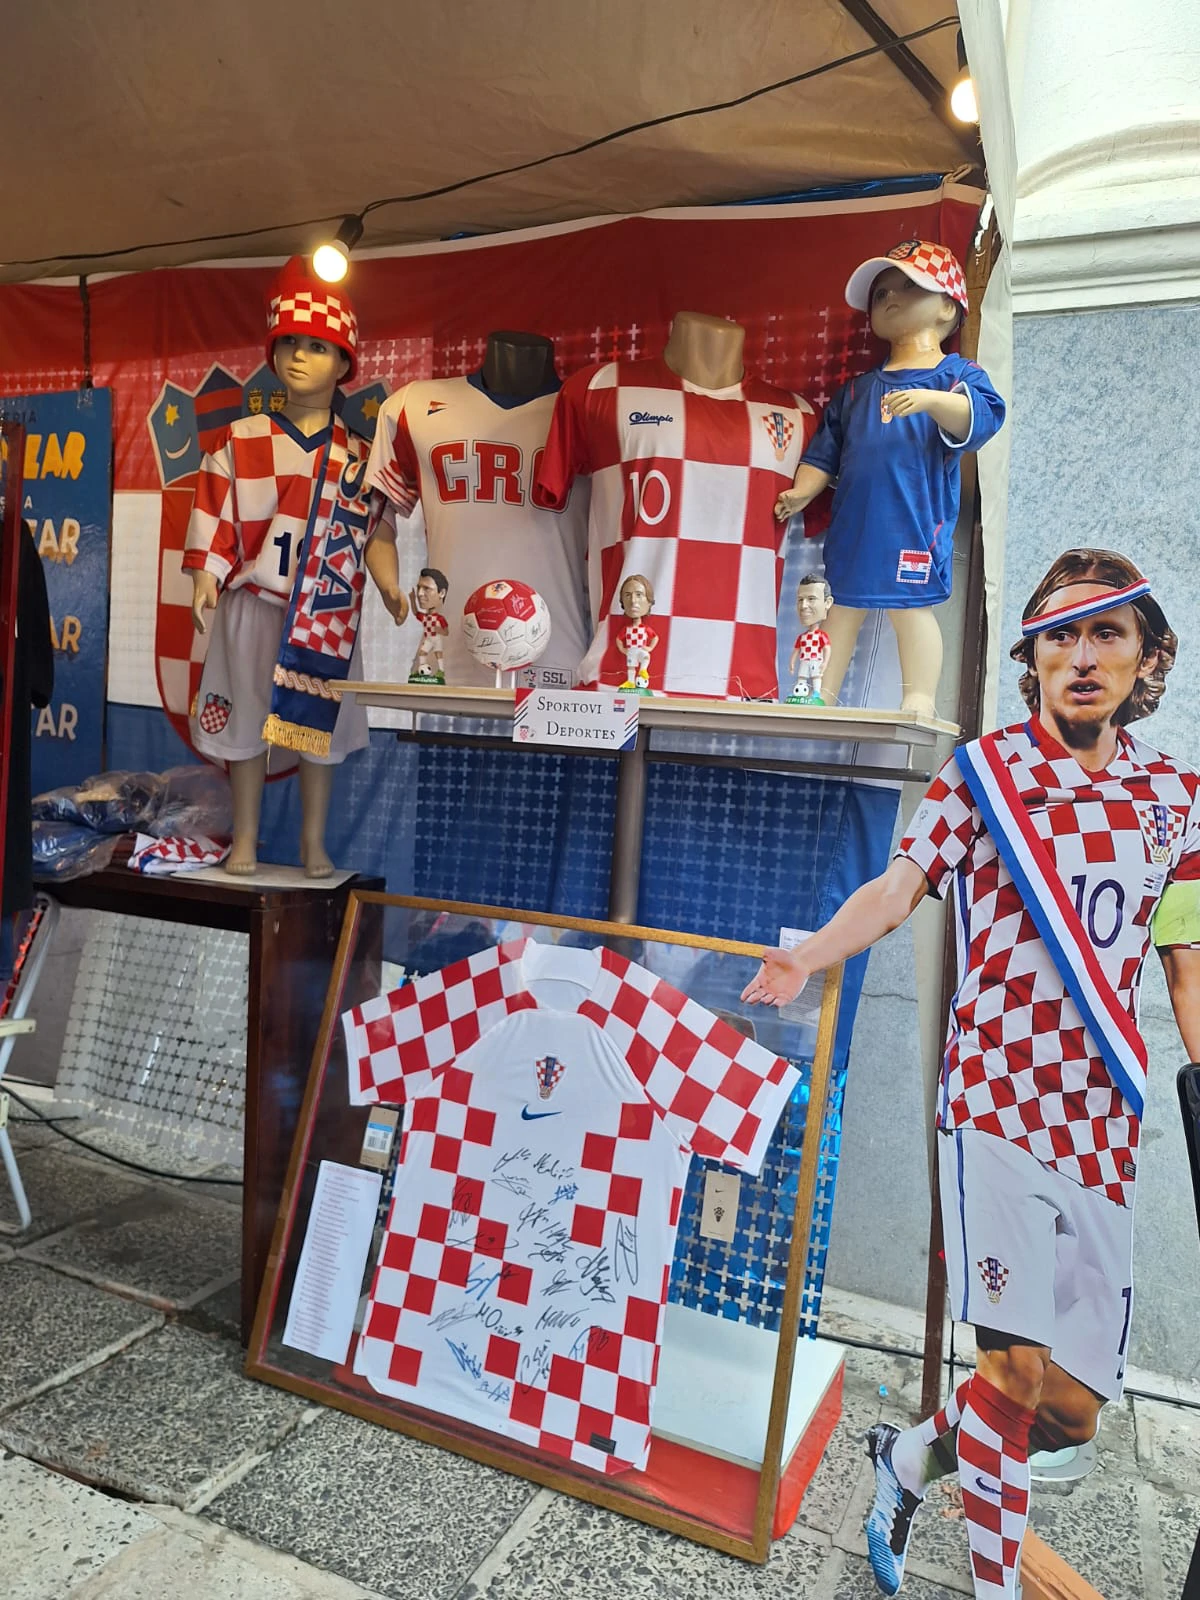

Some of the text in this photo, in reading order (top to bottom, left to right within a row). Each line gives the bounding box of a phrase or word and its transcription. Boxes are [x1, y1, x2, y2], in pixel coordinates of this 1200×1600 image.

[629, 411, 673, 426] Olimpic
[629, 469, 671, 525] 10
[542, 671, 567, 685] SSL
[1071, 874, 1125, 949] 10
